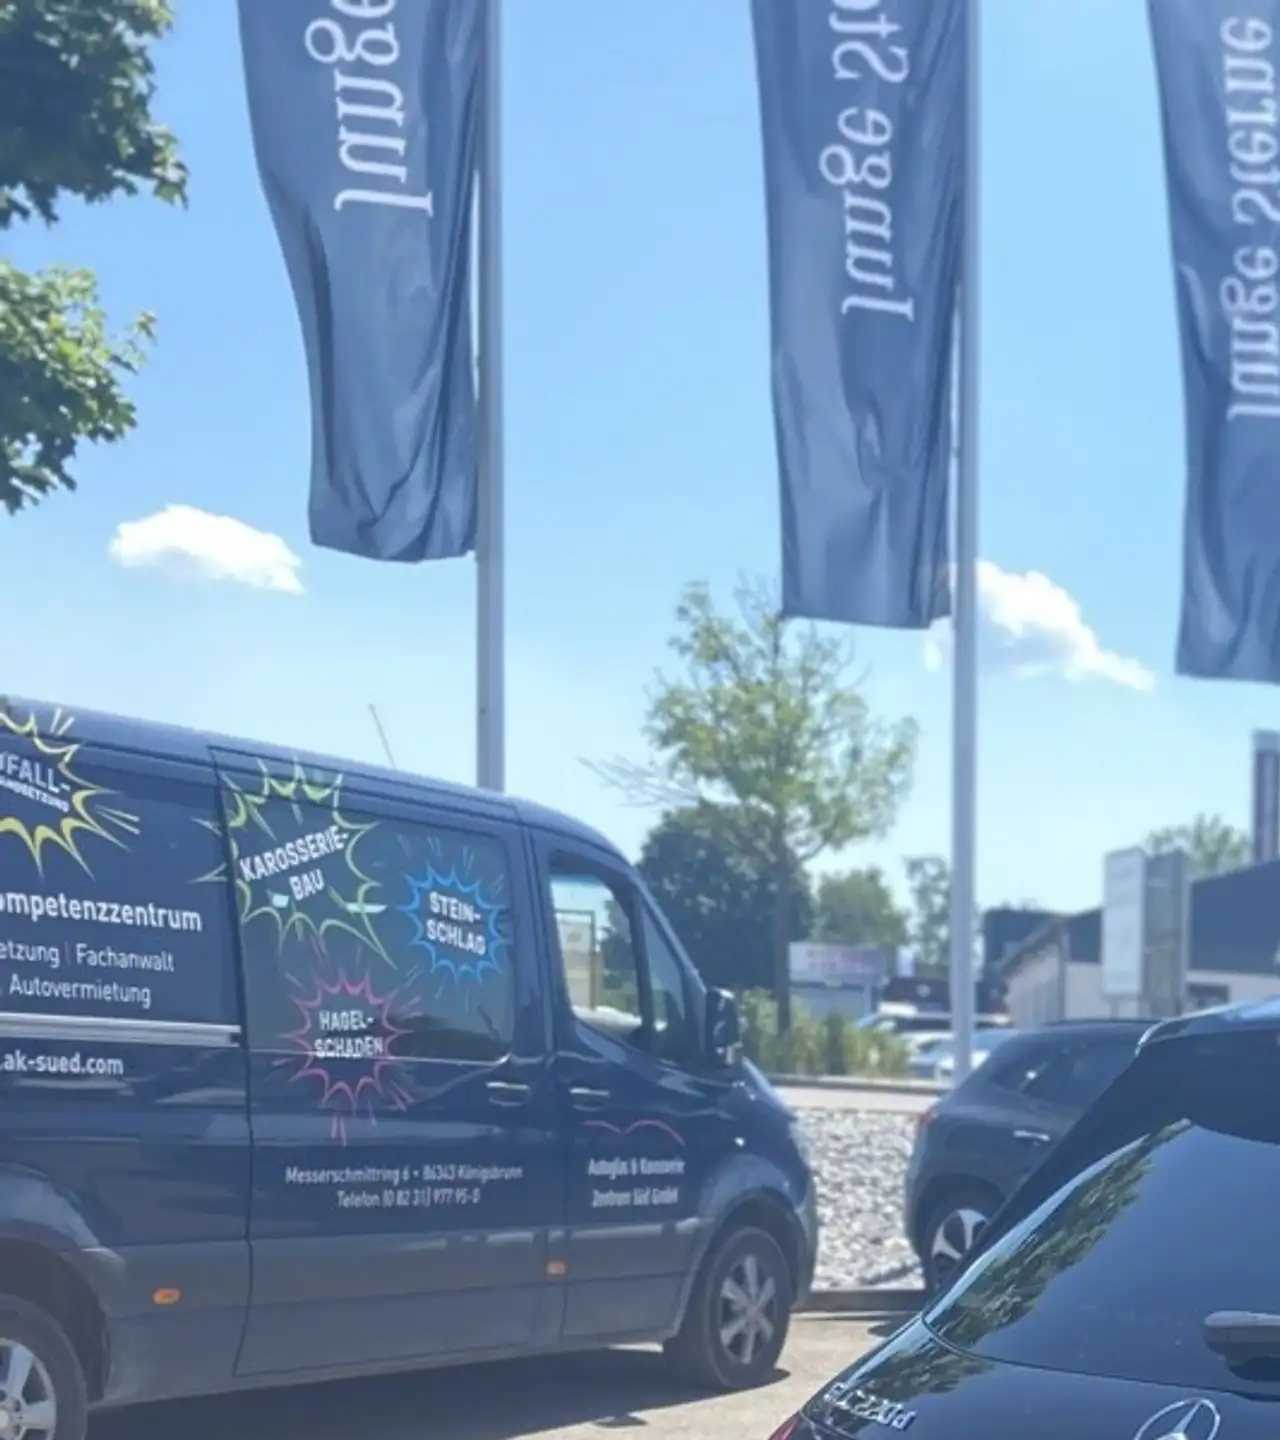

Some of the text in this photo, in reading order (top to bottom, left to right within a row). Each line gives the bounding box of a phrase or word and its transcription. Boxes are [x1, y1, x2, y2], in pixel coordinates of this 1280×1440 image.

[240, 825, 349, 882] KAROSSERIE-
[288, 869, 324, 900] BAU
[428, 891, 482, 922] STEIN-
[426, 919, 486, 956] SCHLAG
[75, 943, 175, 972] Fachanwalt
[9, 973, 151, 1009] Autovermietung
[318, 1009, 374, 1032] HAGEL-
[313, 1035, 384, 1059] SCHADEN
